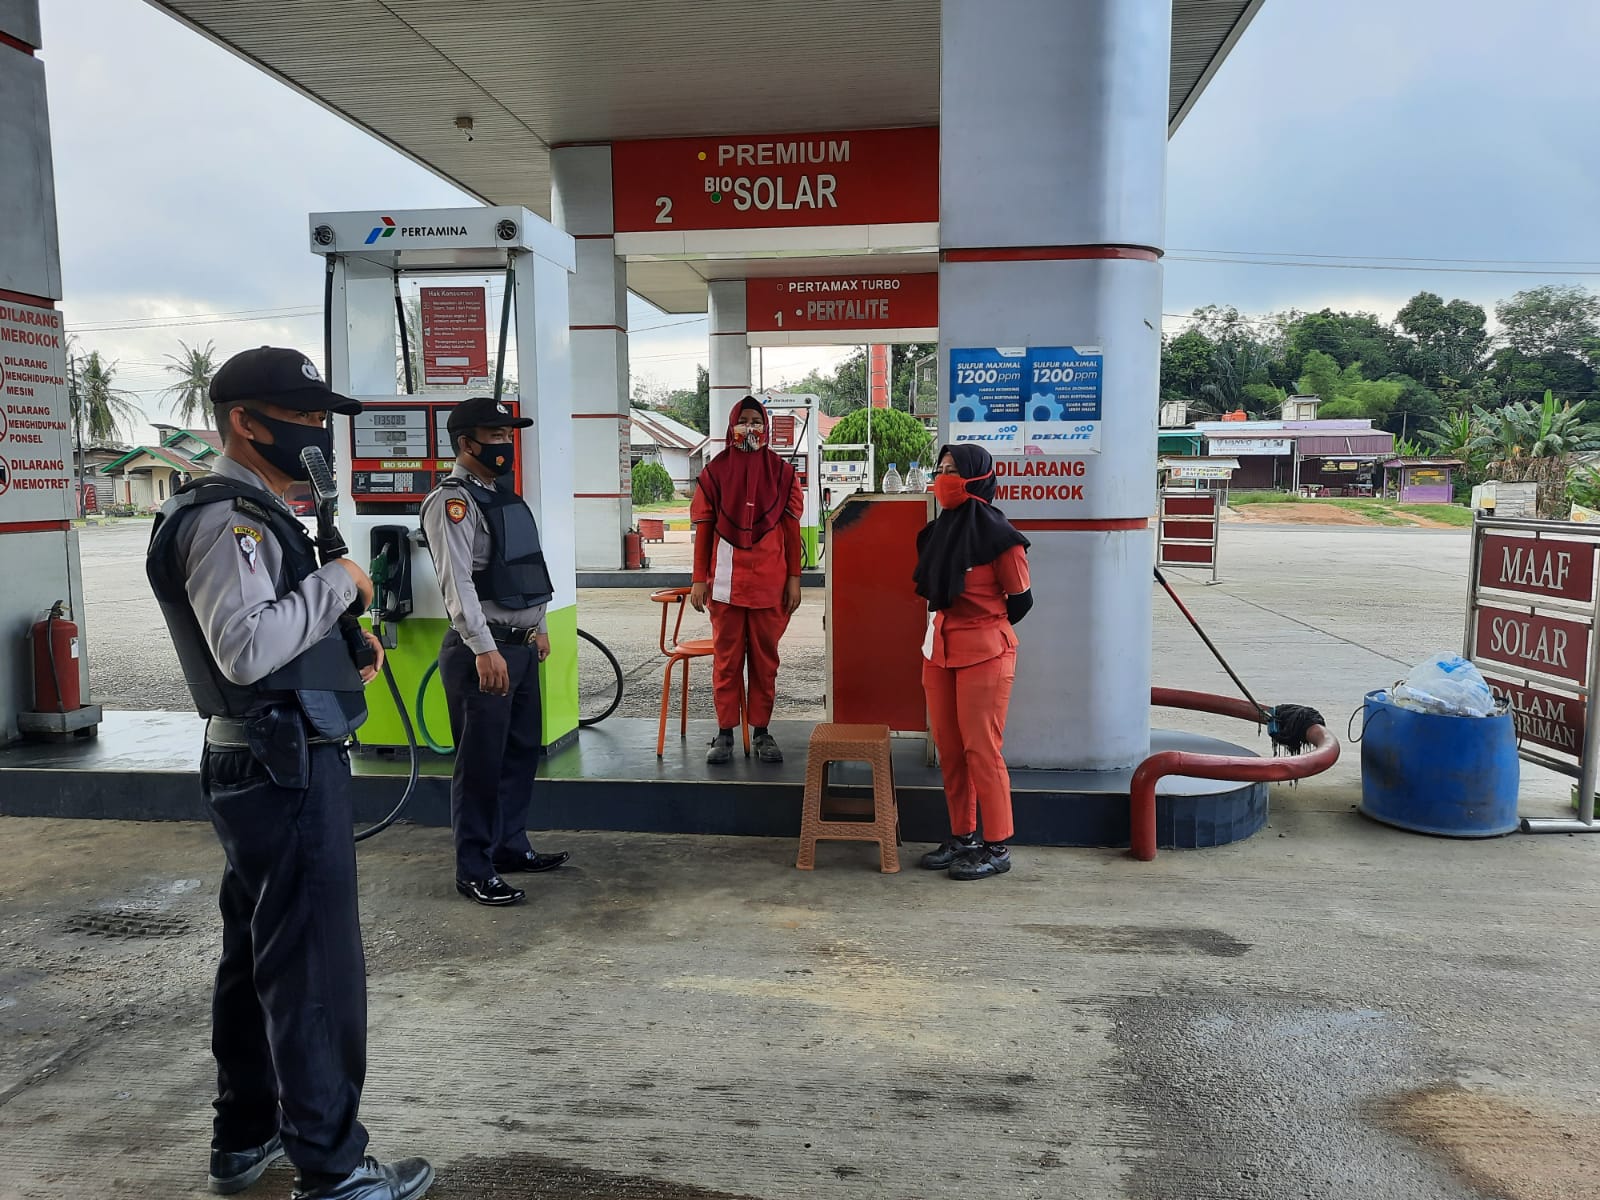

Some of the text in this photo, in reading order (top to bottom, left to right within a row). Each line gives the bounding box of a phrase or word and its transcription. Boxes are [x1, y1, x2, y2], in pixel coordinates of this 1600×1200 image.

[718, 140, 850, 166] PREMIUM
[704, 174, 837, 211] BIO SOLAR
[655, 197, 673, 223] 2
[401, 226, 468, 237] PERTAMINA
[789, 279, 900, 293] PERTAMAX TURBO
[0, 306, 59, 329] DILARANG
[807, 299, 889, 321] PERTALITE
[774, 312, 783, 327] 1
[1, 327, 60, 349] MEROKOK
[4, 356, 48, 370] DILARANG
[957, 361, 1021, 370] SULFUR MAXIMAL
[1033, 360, 1098, 369] SULFUR MAXIMAL
[5, 371, 65, 385] MENGHIDUPKAN
[957, 369, 1021, 384] 1200 ppm
[1033, 368, 1098, 383] 1200 ppm
[6, 386, 34, 397] MESIN
[7, 405, 51, 416] DILARANG
[8, 419, 67, 430] MENGHIDUPKAN
[10, 434, 44, 444] PONSEL
[11, 459, 65, 471] DILARANG
[995, 461, 1085, 477] DILARANG
[13, 478, 70, 490] MEMOTRET
[994, 484, 1084, 500] MEROKOK
[1499, 546, 1571, 590] MAAF
[1490, 616, 1568, 668] SOLAR
[1488, 684, 1566, 724] DALAM
